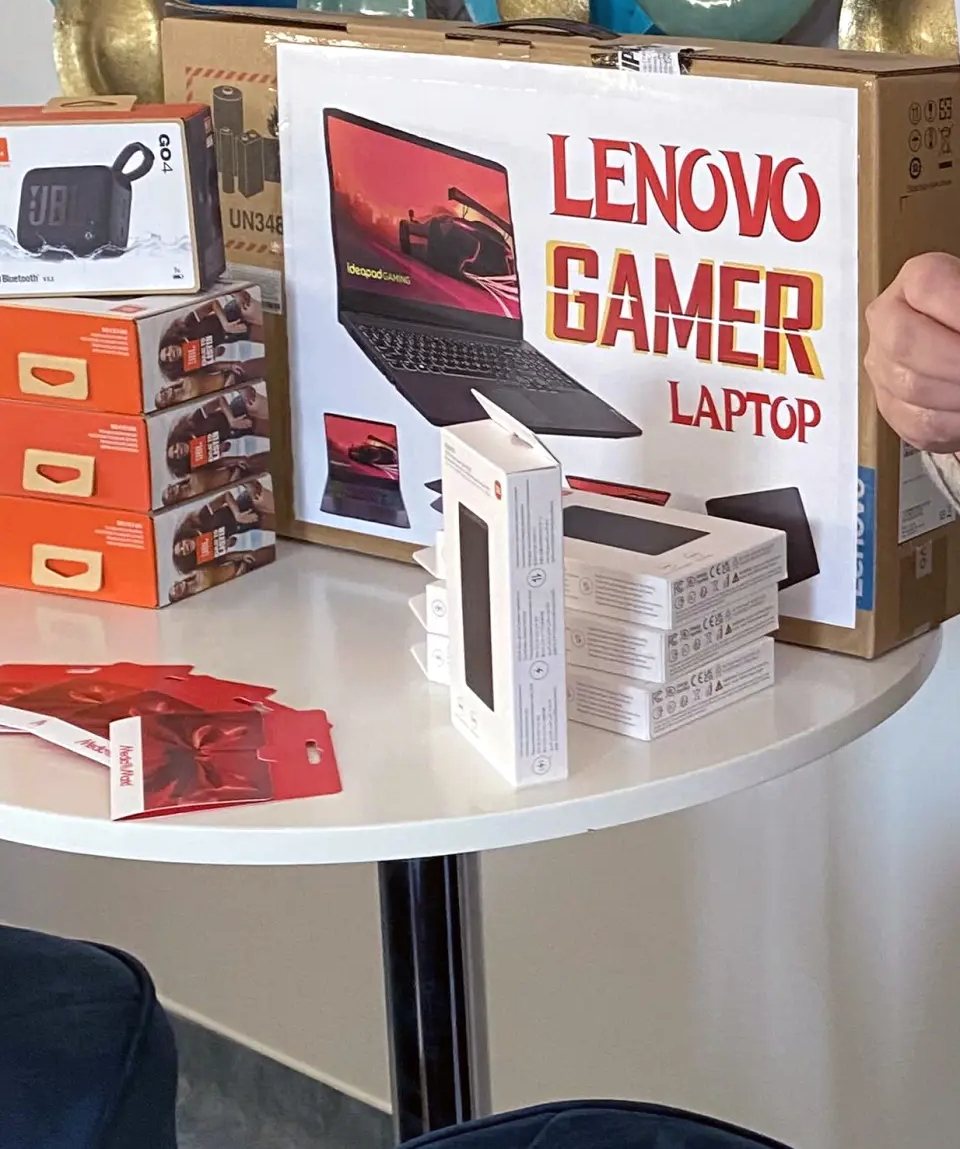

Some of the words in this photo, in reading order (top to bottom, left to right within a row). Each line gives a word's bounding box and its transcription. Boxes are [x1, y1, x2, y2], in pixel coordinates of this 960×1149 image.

[547, 133, 821, 242] LENOVO
[545, 239, 825, 379] GAMER
[668, 380, 821, 443] LAPTOP
